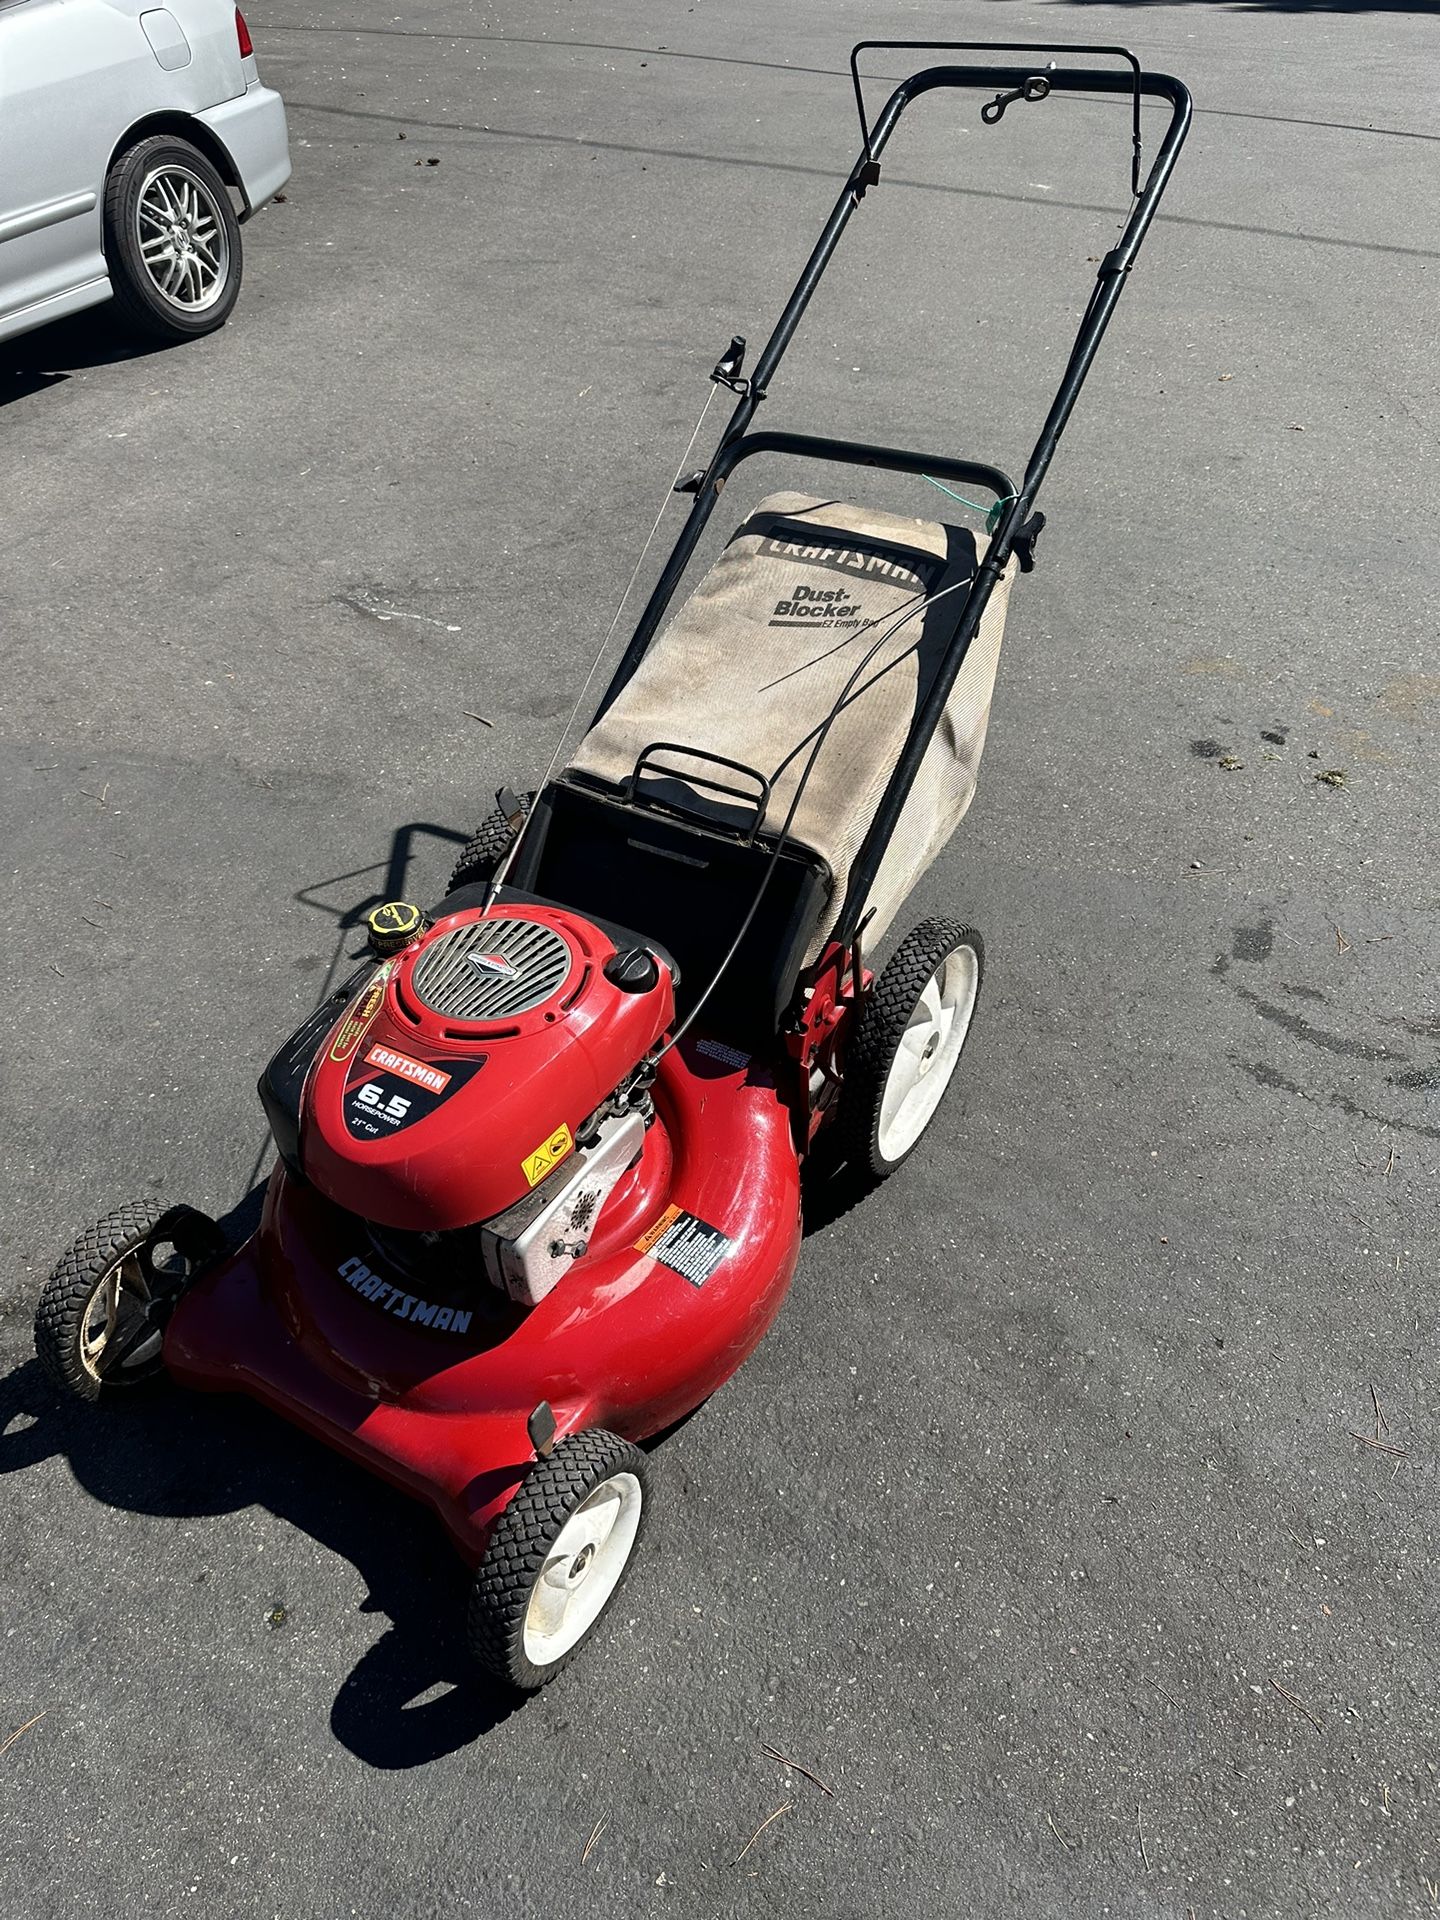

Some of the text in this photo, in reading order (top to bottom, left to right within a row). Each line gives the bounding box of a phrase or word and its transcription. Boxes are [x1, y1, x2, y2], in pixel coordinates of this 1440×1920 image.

[769, 534, 936, 585] CRAFTSMAN
[792, 586, 850, 602] Dust-
[773, 601, 861, 617] Blocker
[822, 618, 880, 629] EZ Empty Bag
[370, 1048, 445, 1089] CRAFTSMAN
[352, 1100, 401, 1126] HORSEPOWER
[357, 1083, 412, 1118] 6.5
[365, 1122, 379, 1134] Cut
[337, 1256, 473, 1334] CRAFTSMAN
